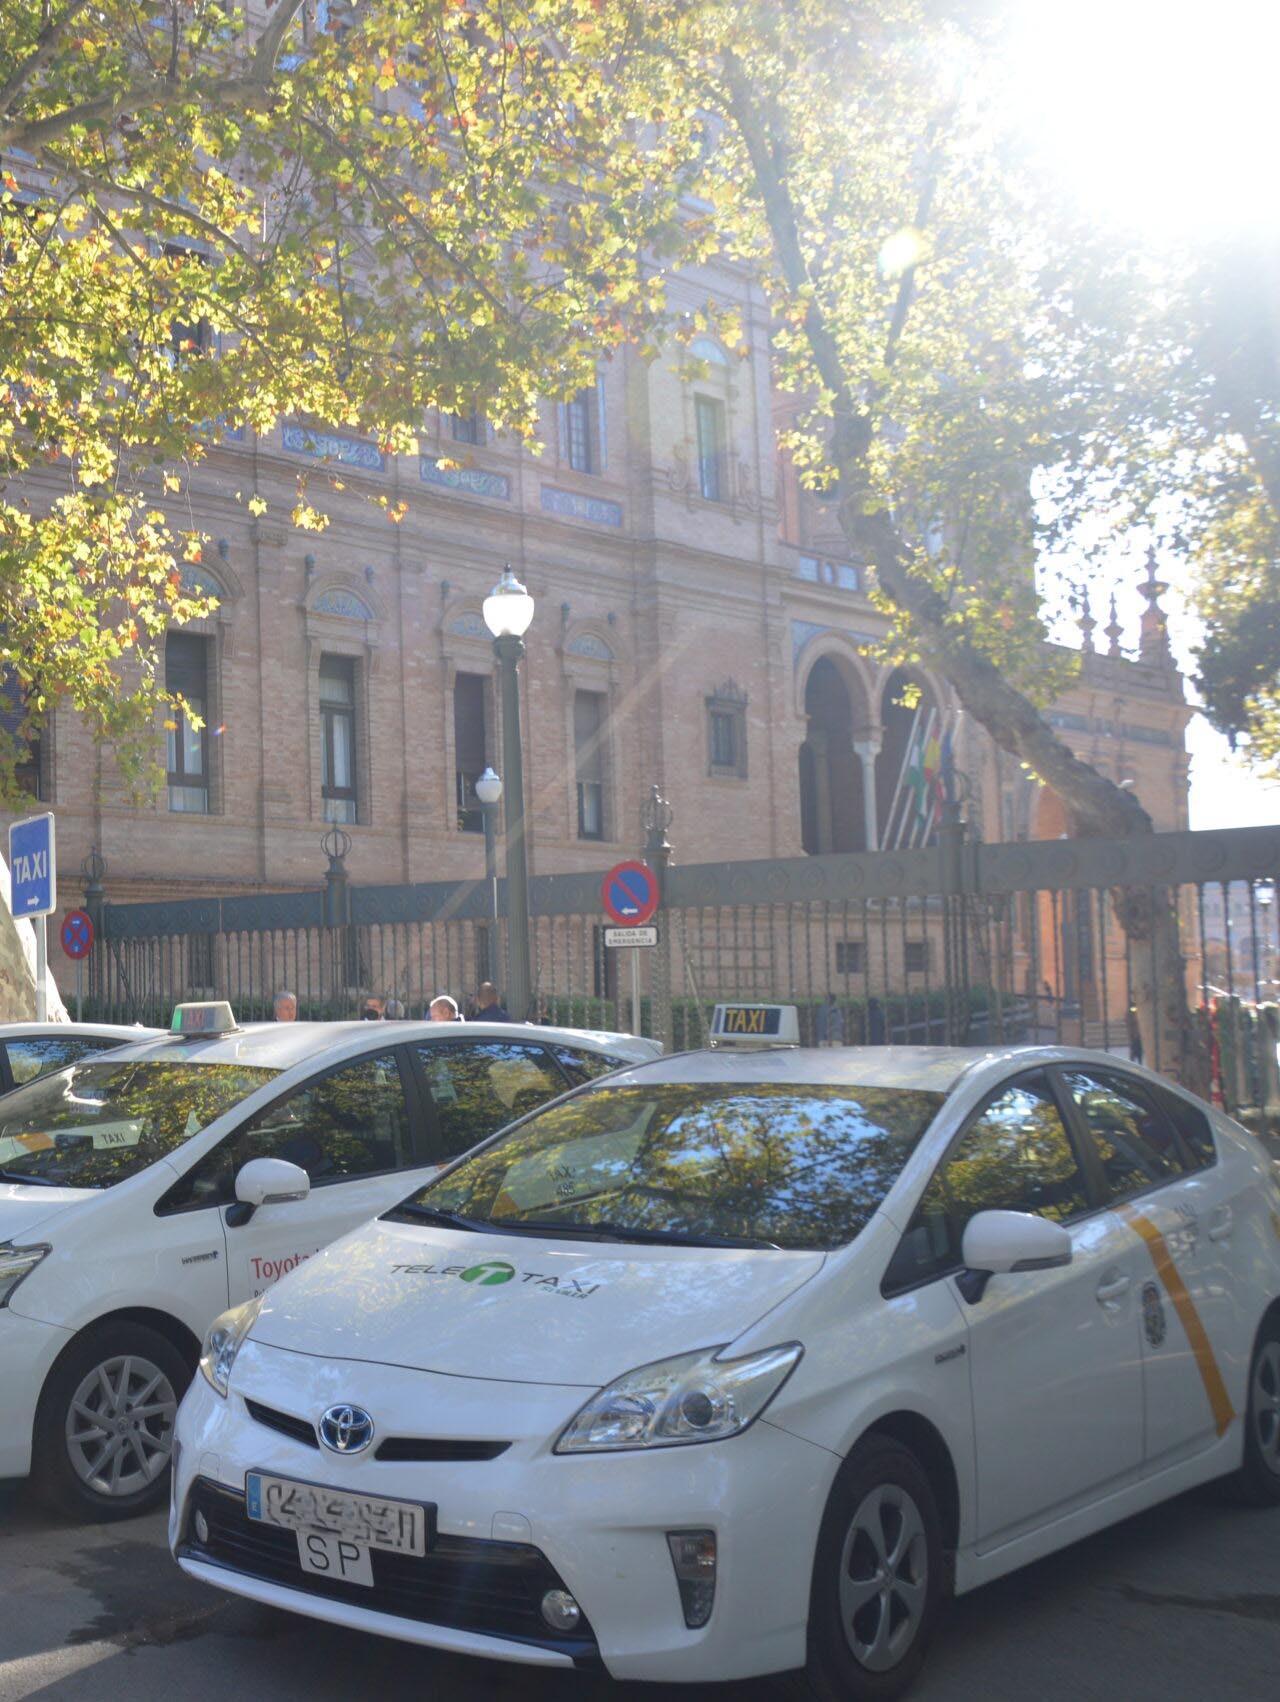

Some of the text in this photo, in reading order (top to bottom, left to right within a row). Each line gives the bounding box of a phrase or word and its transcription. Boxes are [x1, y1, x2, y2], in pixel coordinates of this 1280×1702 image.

[13, 850, 47, 884] TAXI
[726, 1008, 766, 1032] TAXI
[101, 1133, 125, 1145] TAXI
[390, 1264, 467, 1275] TELE
[521, 1272, 600, 1295] TAXI
[306, 1534, 360, 1576] SP
